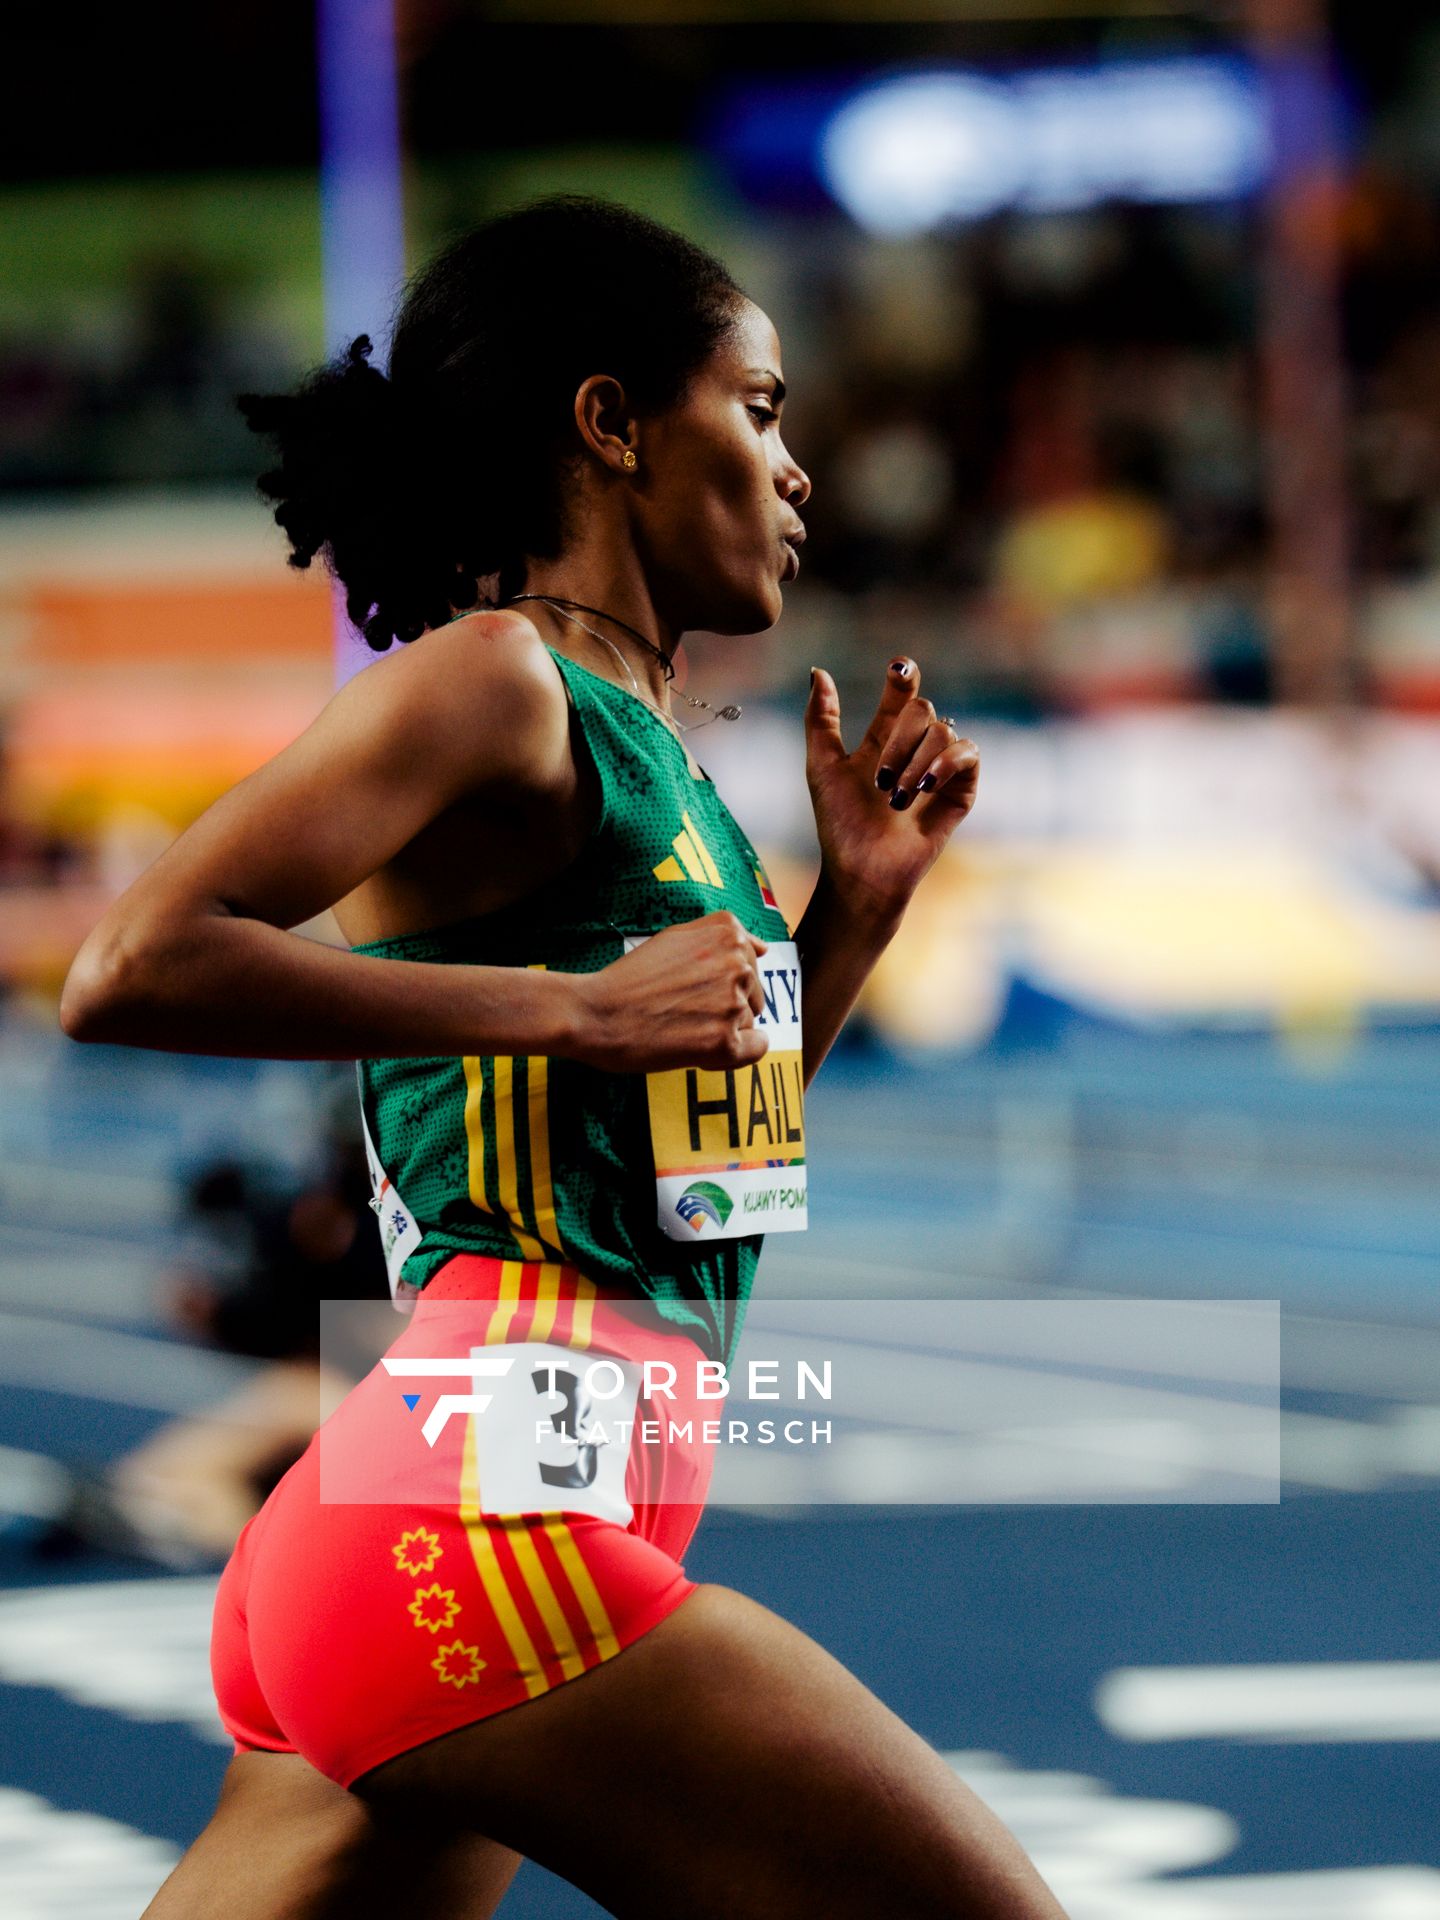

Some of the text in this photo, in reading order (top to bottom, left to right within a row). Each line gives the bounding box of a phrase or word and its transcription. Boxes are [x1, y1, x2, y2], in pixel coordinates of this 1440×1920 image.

[759, 968, 799, 1025] NY
[779, 1186, 808, 1211] POM
[531, 1368, 598, 1489] 3
